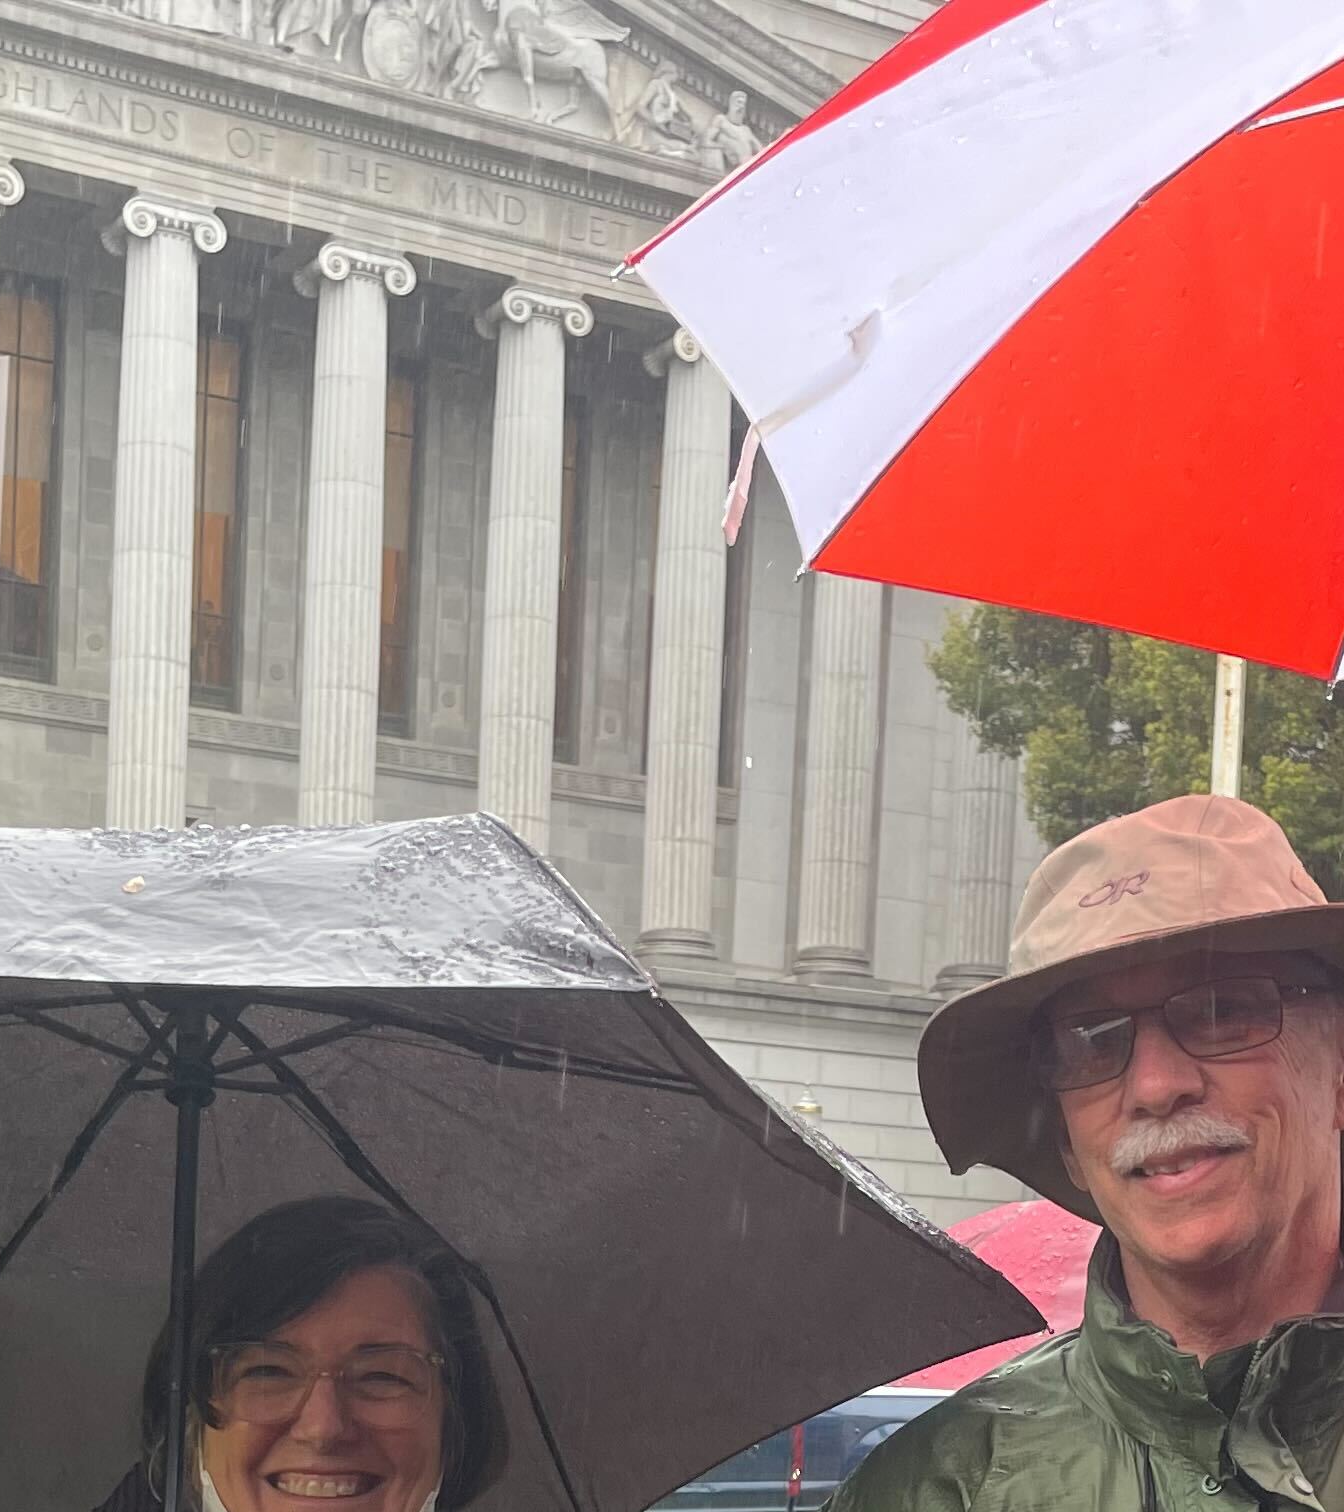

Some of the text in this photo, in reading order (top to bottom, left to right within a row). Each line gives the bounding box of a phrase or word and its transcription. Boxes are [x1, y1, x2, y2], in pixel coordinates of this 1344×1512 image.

[226, 127, 275, 159] OF
[318, 147, 393, 194] THE
[431, 176, 527, 227] MIND
[566, 205, 632, 249] LET
